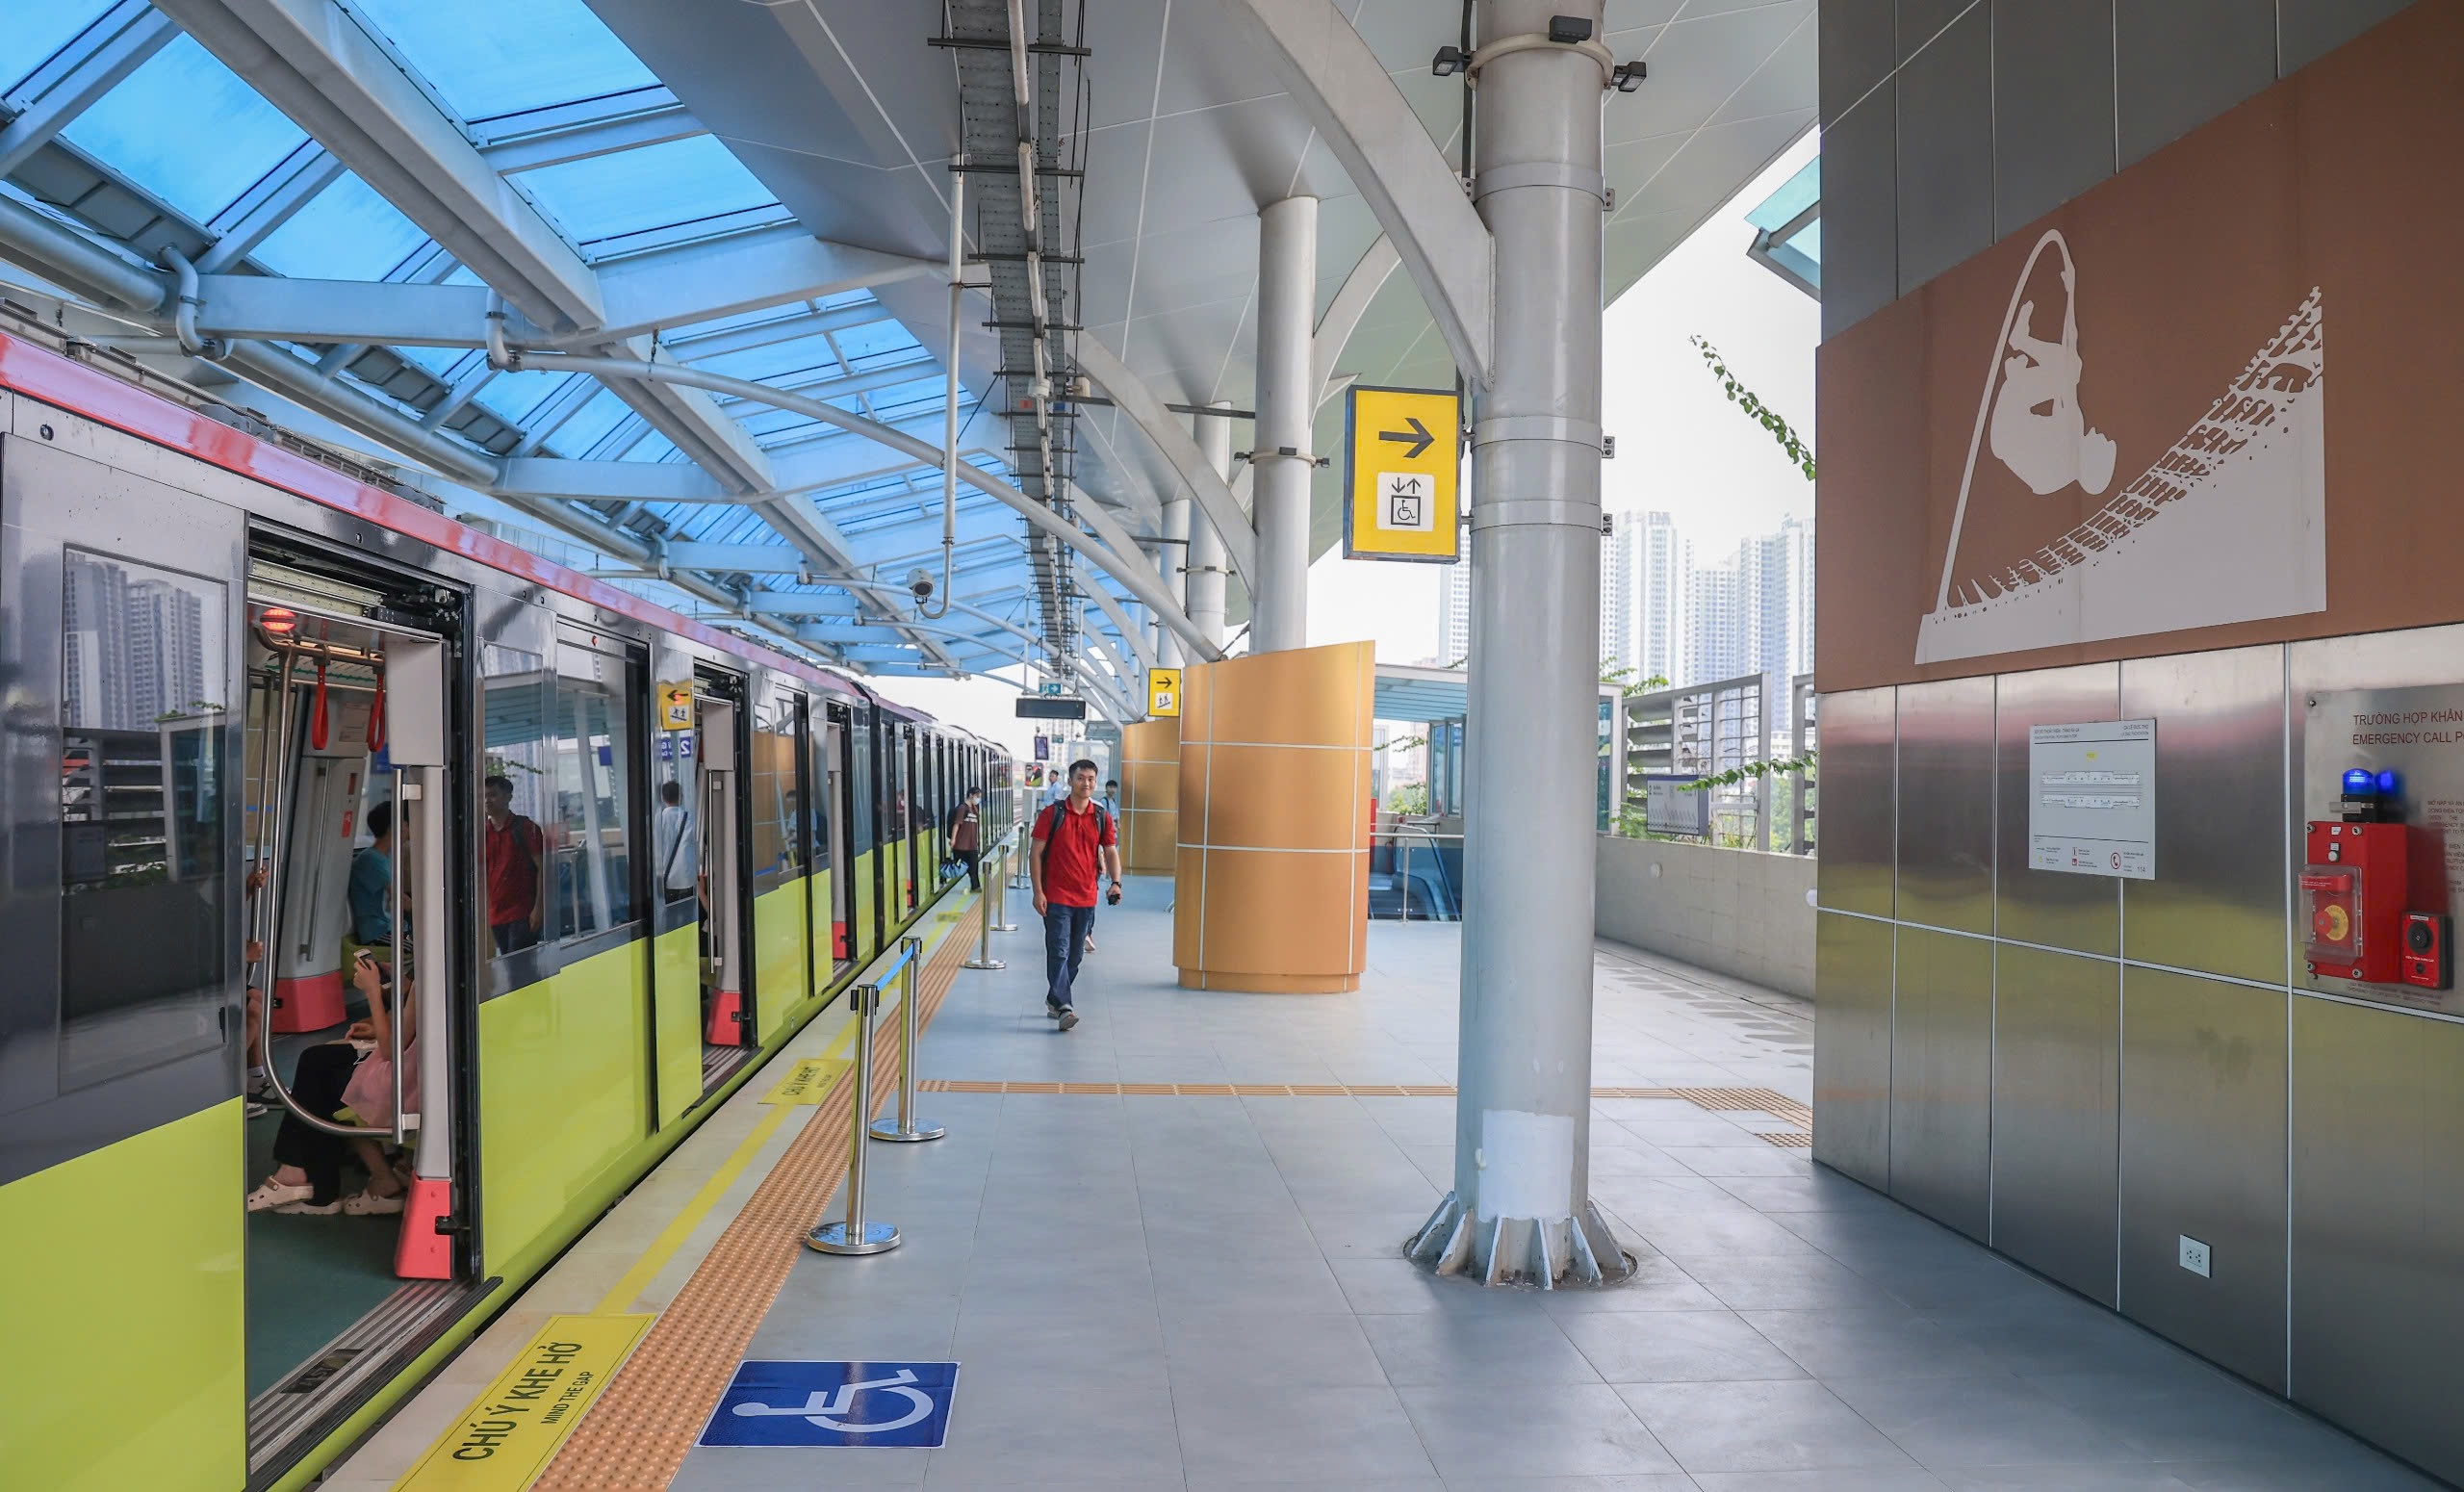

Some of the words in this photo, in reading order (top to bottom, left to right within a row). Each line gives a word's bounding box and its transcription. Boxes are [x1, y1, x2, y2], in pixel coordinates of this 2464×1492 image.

[2352, 711, 2400, 725] TRƯỜNG
[2352, 732, 2421, 745] EMERGENCY
[2424, 732, 2452, 743] CALL
[504, 1369, 564, 1400] KHE
[540, 1403, 570, 1424] MIND
[558, 1387, 583, 1402] THE
[572, 1371, 594, 1386] GAP
[484, 1404, 530, 1416] Ý
[452, 1421, 517, 1460] CHÚ
